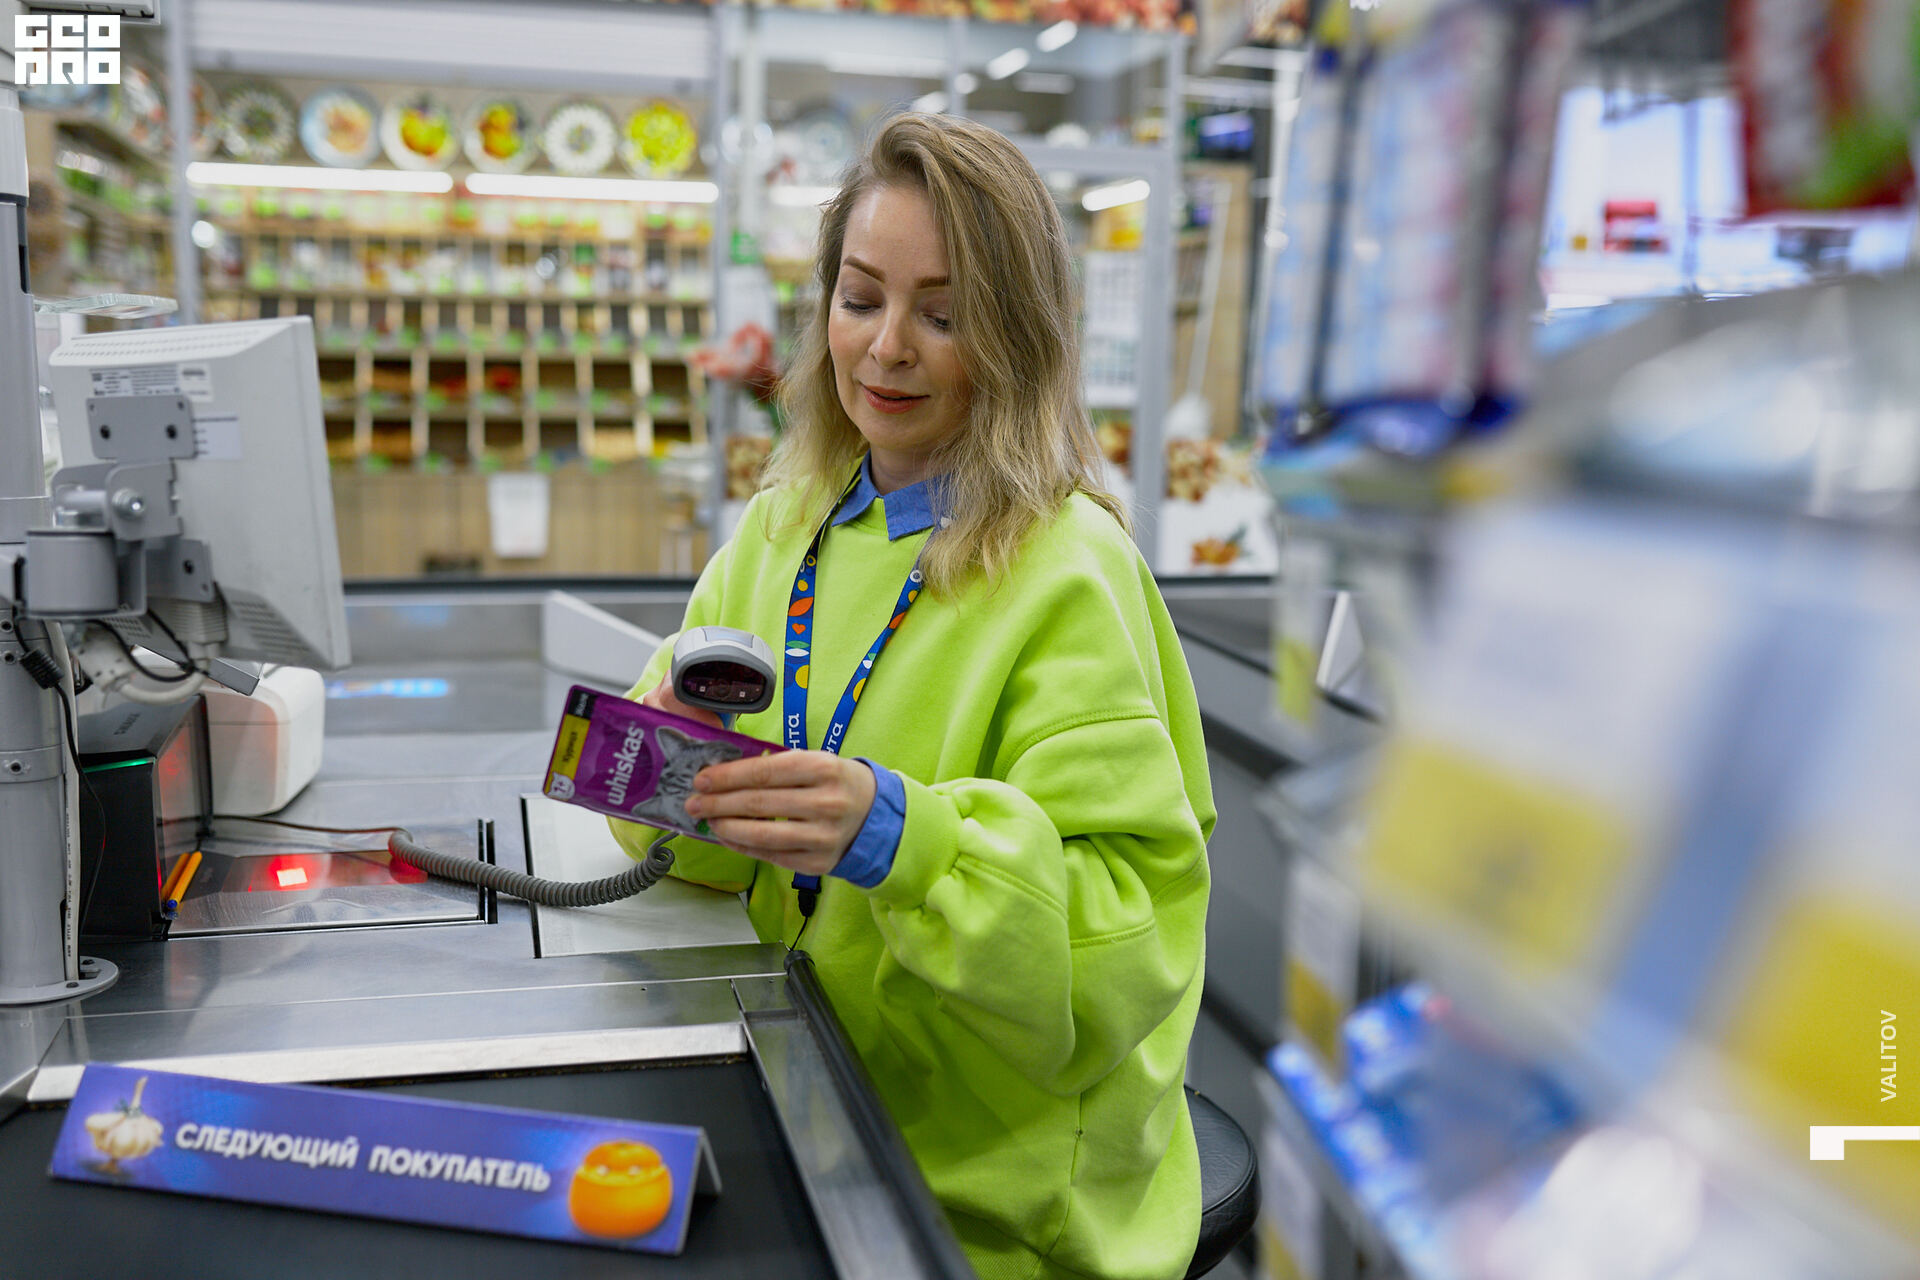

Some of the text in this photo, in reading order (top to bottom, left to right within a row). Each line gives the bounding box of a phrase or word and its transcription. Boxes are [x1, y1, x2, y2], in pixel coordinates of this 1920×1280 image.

[604, 725, 645, 806] whiskas
[175, 1122, 551, 1192] СЛЕДУЮЩИЙ ПОКУПАТЕЛЬ
